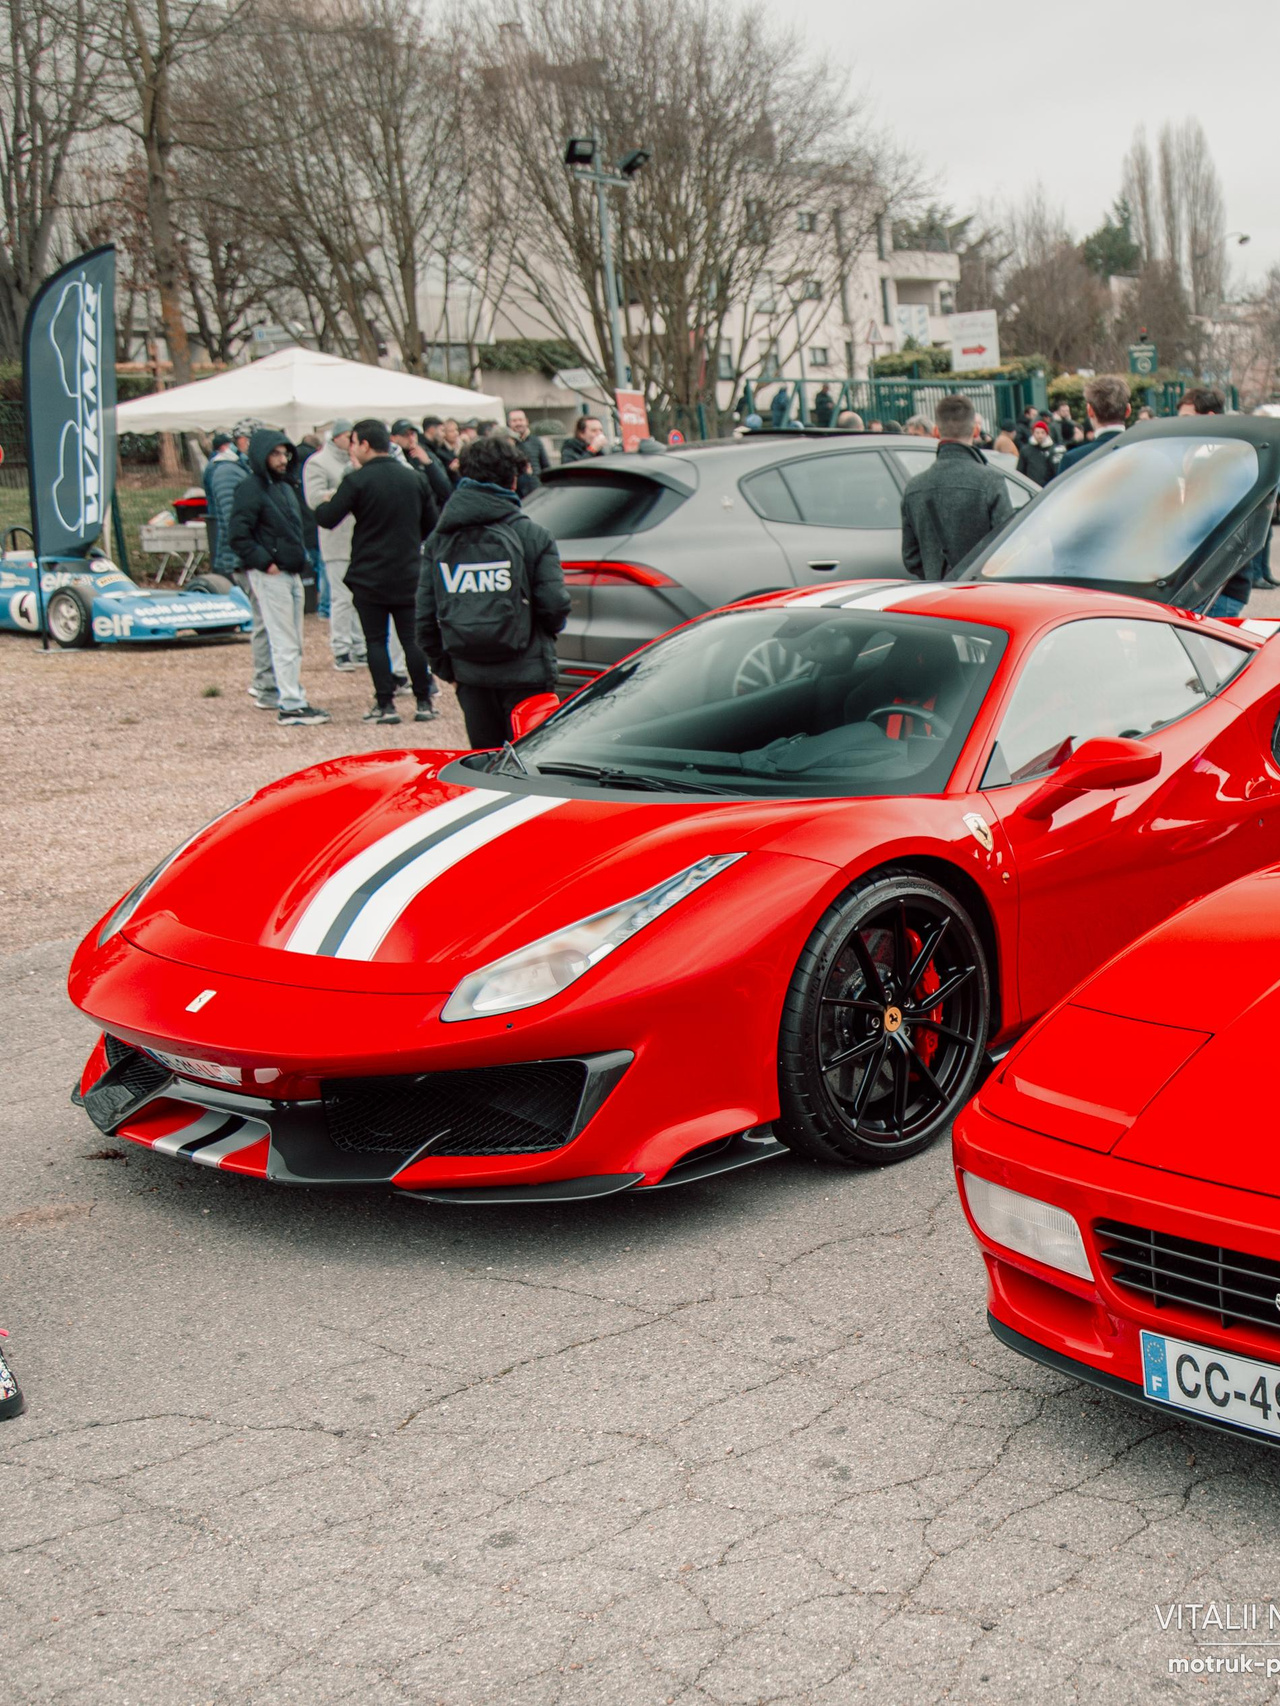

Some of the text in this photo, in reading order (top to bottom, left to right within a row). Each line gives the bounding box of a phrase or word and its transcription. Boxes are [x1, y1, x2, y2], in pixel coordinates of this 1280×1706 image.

[40, 572, 73, 593] elf
[439, 560, 512, 593] VANS
[18, 593, 32, 624] 4
[92, 613, 135, 637] elf
[1151, 1375, 1163, 1392] F
